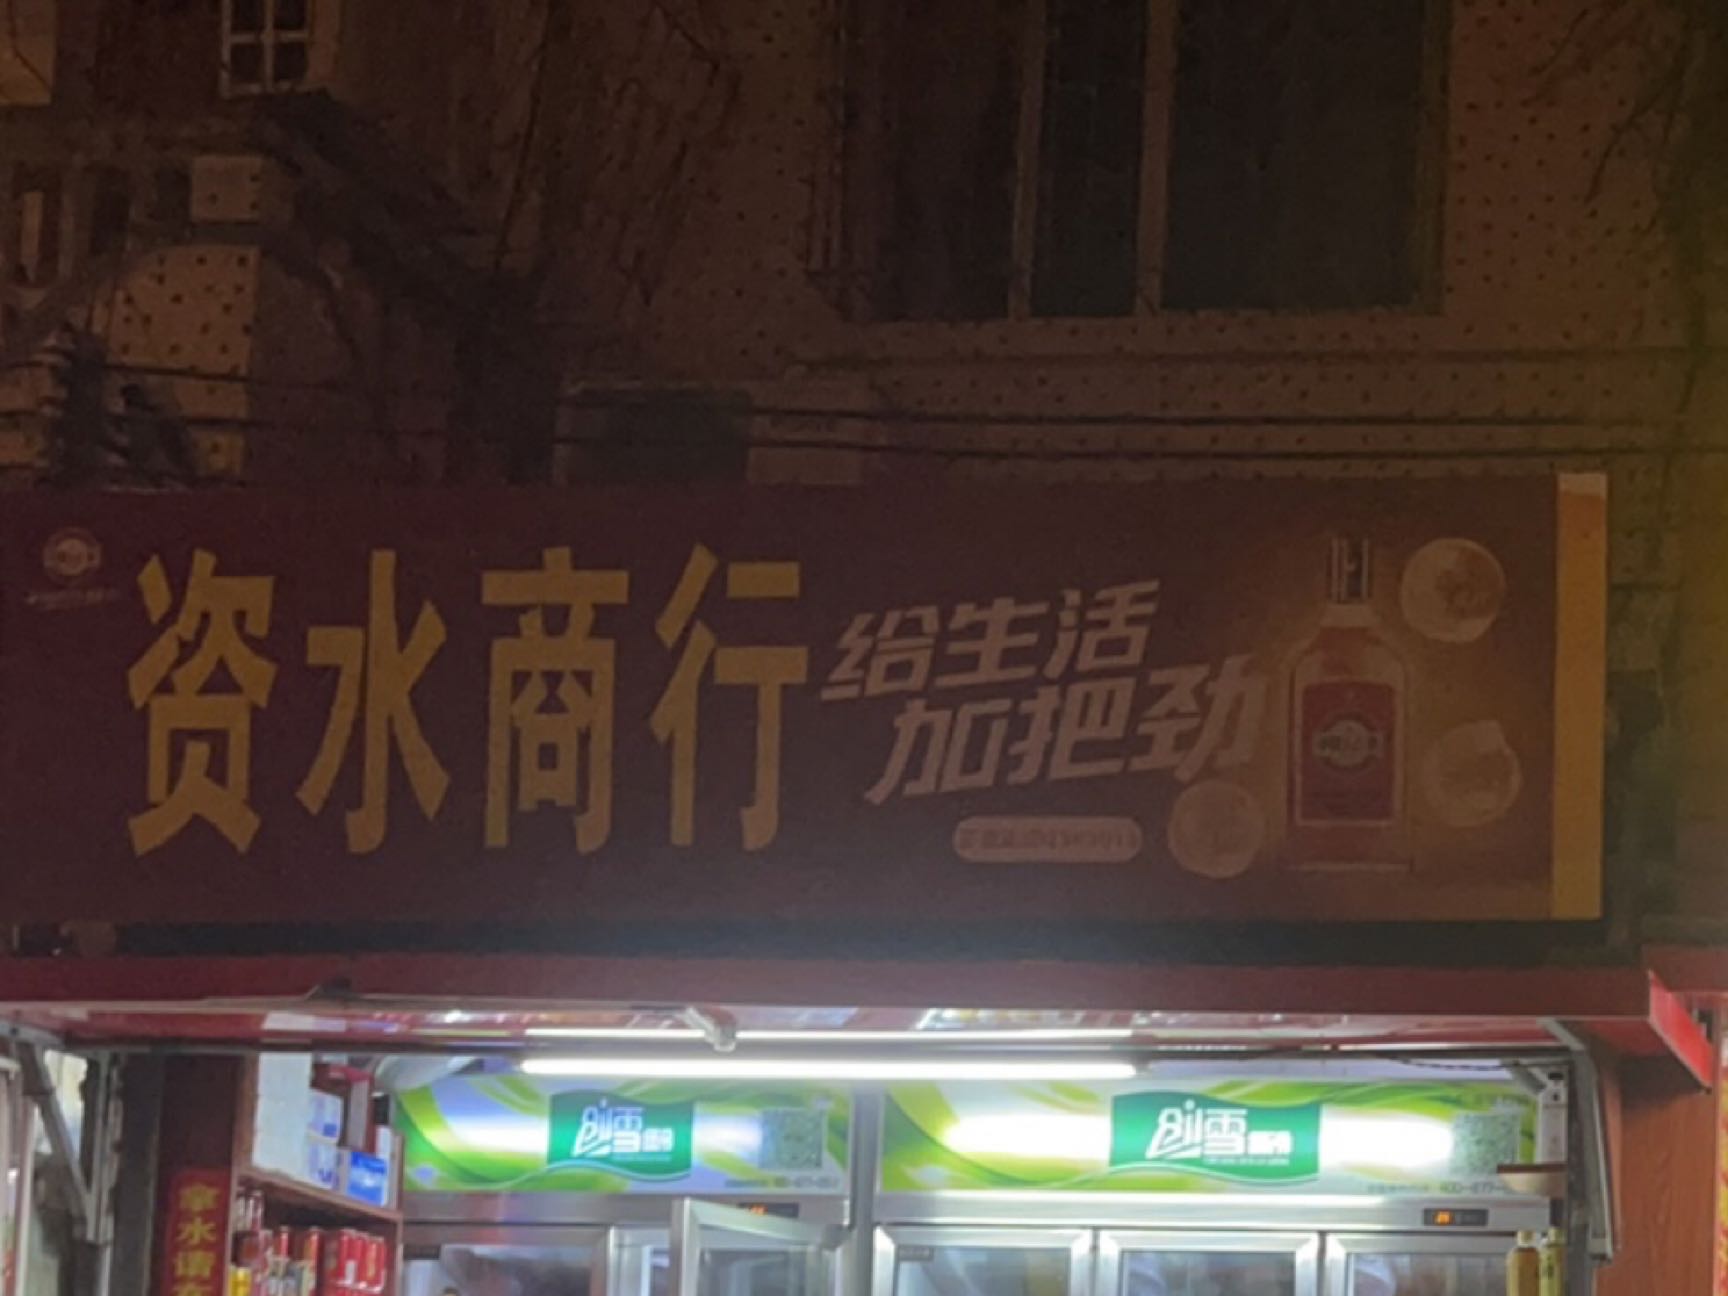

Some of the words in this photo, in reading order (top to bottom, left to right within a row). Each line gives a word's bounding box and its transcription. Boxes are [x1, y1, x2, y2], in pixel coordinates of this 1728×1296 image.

[127, 544, 809, 857] 资水商行
[821, 578, 1161, 701] 给生活
[863, 654, 1274, 805] 加把劲
